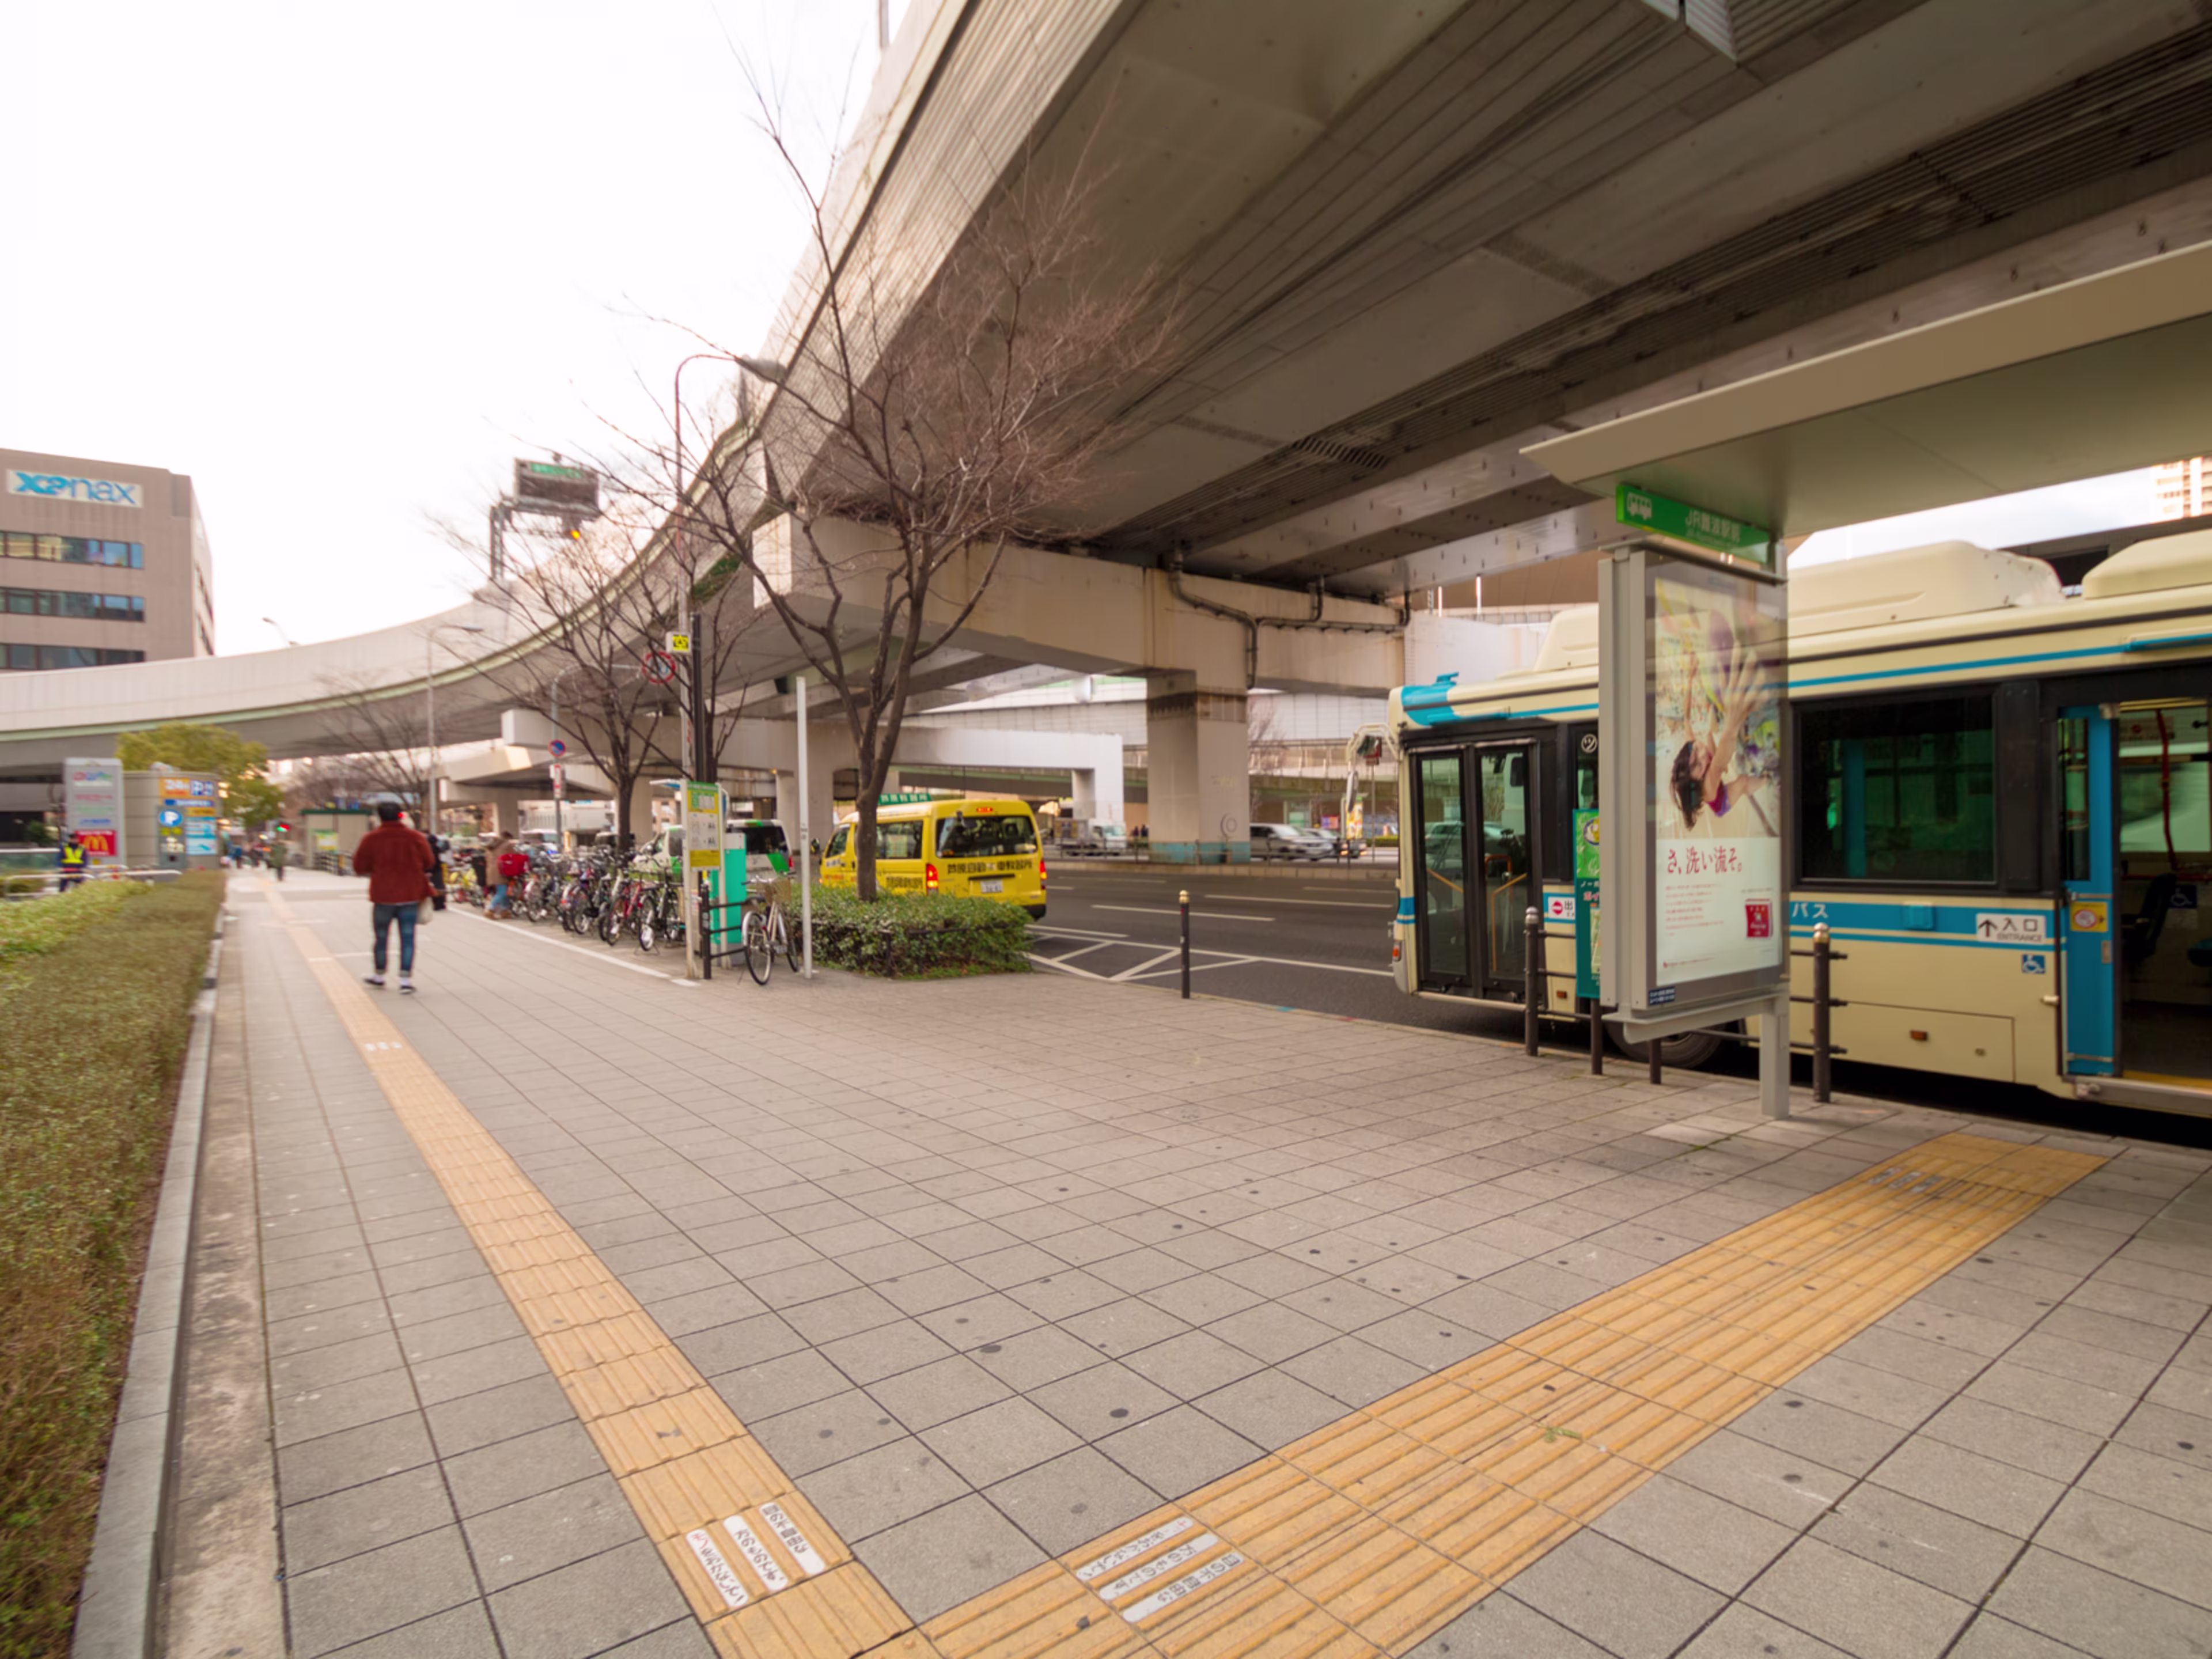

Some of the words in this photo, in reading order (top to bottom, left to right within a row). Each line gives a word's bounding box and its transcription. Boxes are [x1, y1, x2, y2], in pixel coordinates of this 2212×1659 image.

[1667, 846, 1743, 874] さ、洗い流そ。
[2002, 917, 2038, 932] 入口
[1997, 931, 2042, 942] ENTRANCE
